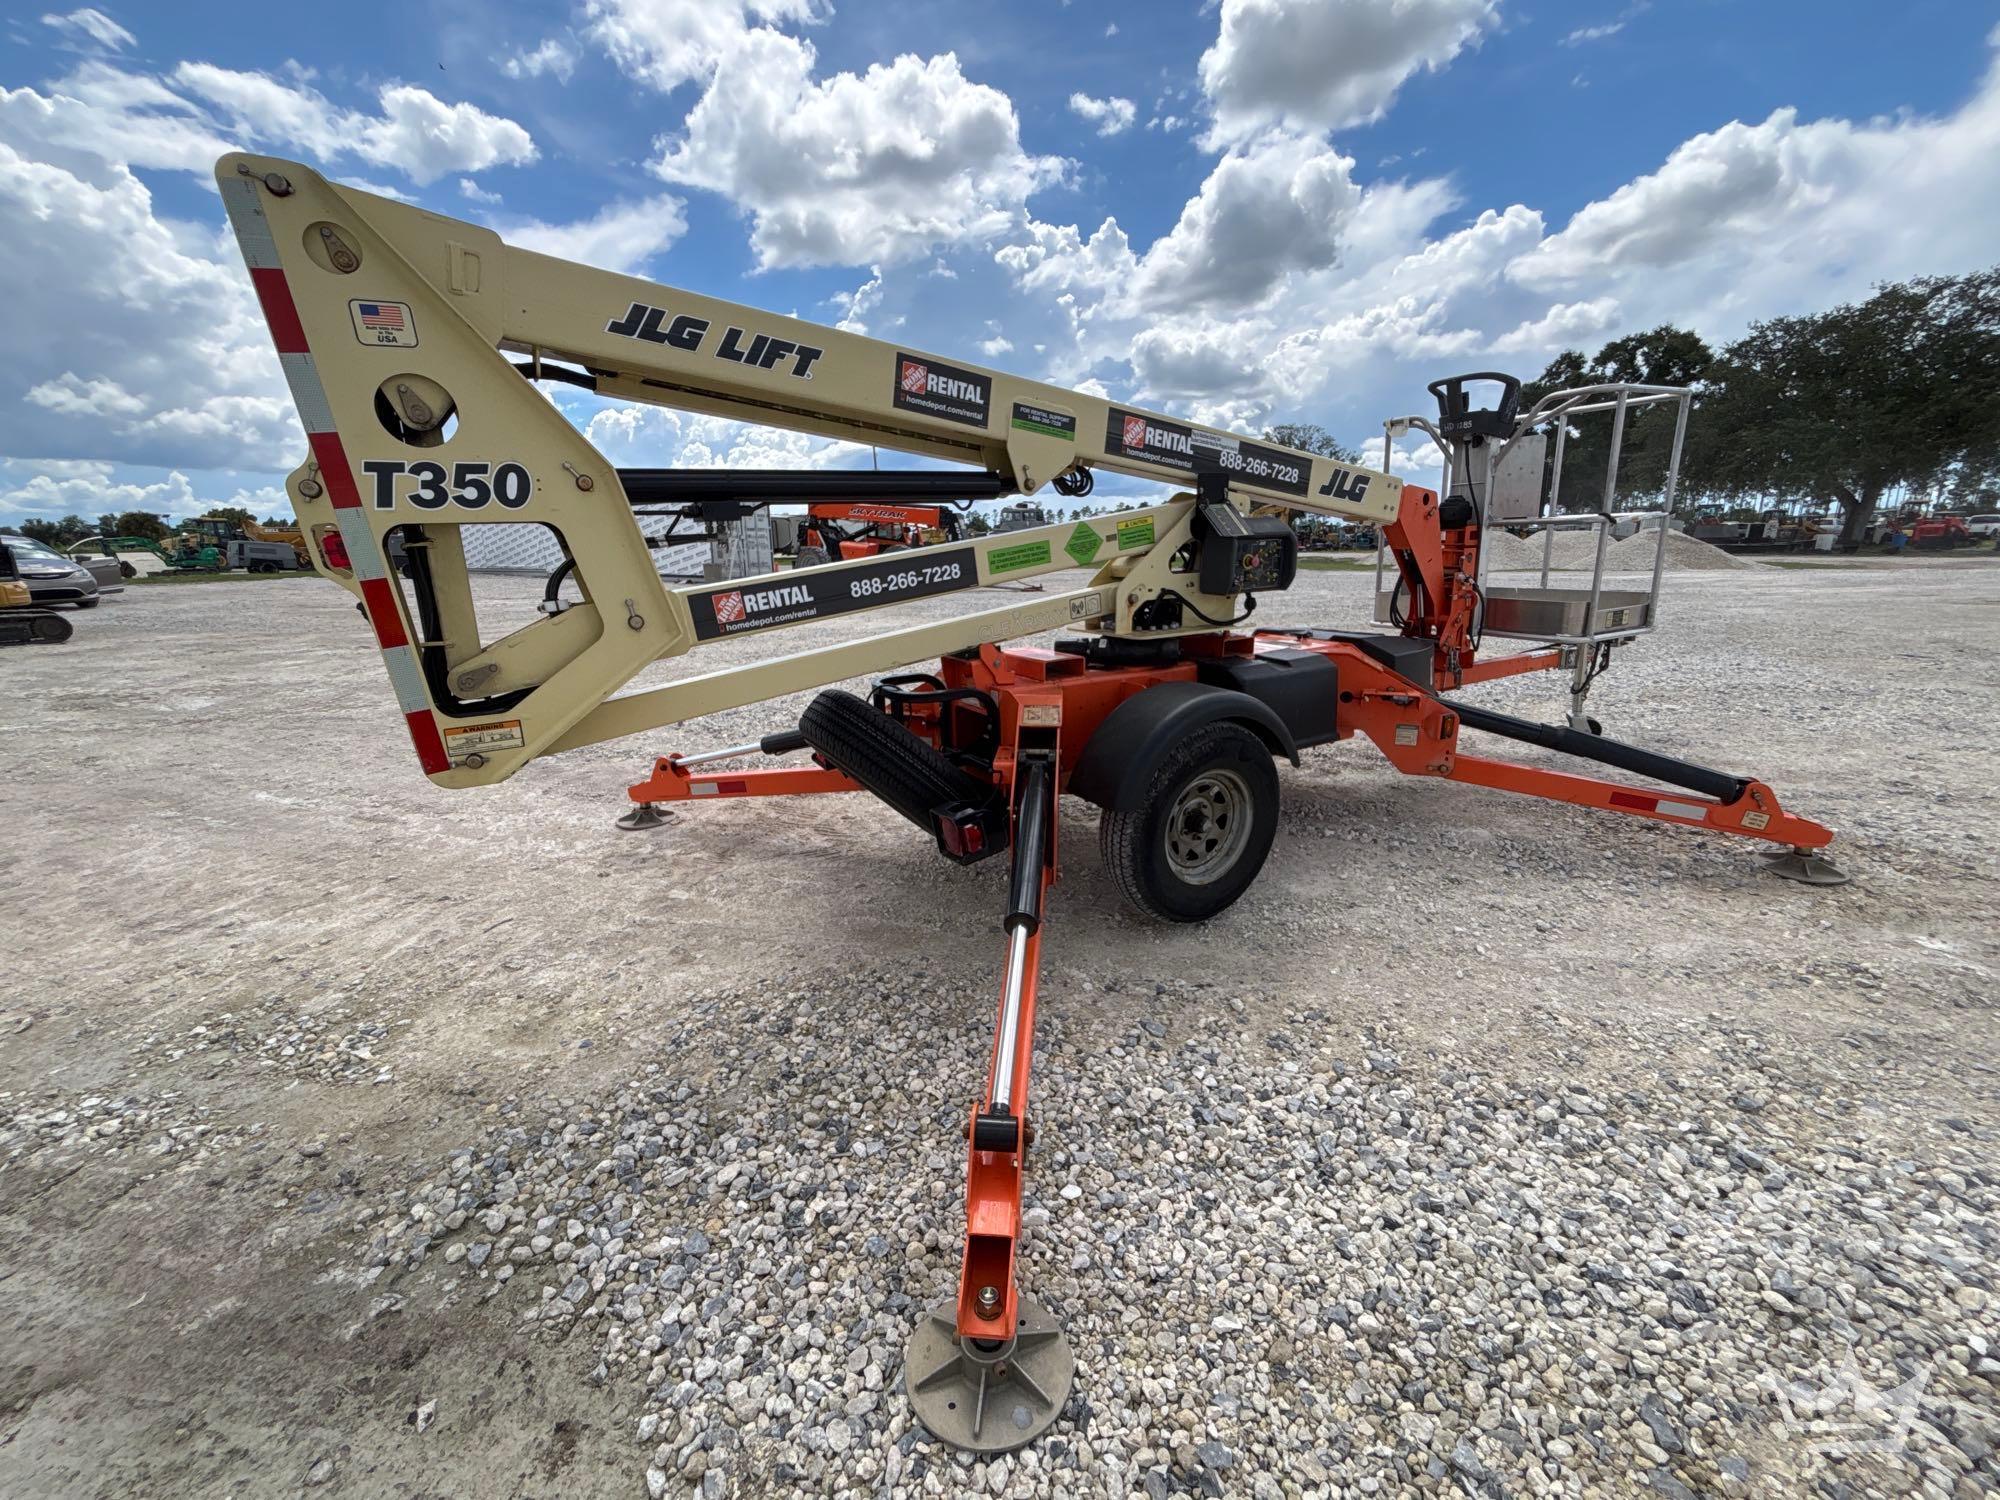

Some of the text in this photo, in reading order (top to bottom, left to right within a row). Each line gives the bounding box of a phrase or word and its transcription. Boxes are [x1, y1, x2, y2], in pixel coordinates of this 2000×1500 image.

[377, 335, 398, 343] USA
[606, 302, 824, 378] JLG LIFT
[902, 366, 926, 389] HOME
[927, 373, 984, 404] RENTAL
[906, 395, 983, 420] homedepot.com/rental
[1049, 413, 1070, 422] SUPPORT
[1124, 420, 1145, 443] HOME
[1145, 426, 1193, 455] RENTAL
[1127, 448, 1192, 469] homedepot.com/rental
[1219, 451, 1299, 484] 888-266-7228
[363, 460, 531, 510] T350
[1319, 468, 1371, 503] JLG
[848, 507, 908, 520] SKYTRAK
[1129, 518, 1149, 527] CAUTION
[850, 563, 961, 598] 888-266-7228
[718, 592, 740, 622] HOME
[743, 584, 814, 613] RENTAL
[726, 607, 817, 632] homedepot.com/rental
[469, 723, 504, 733] WARNING
